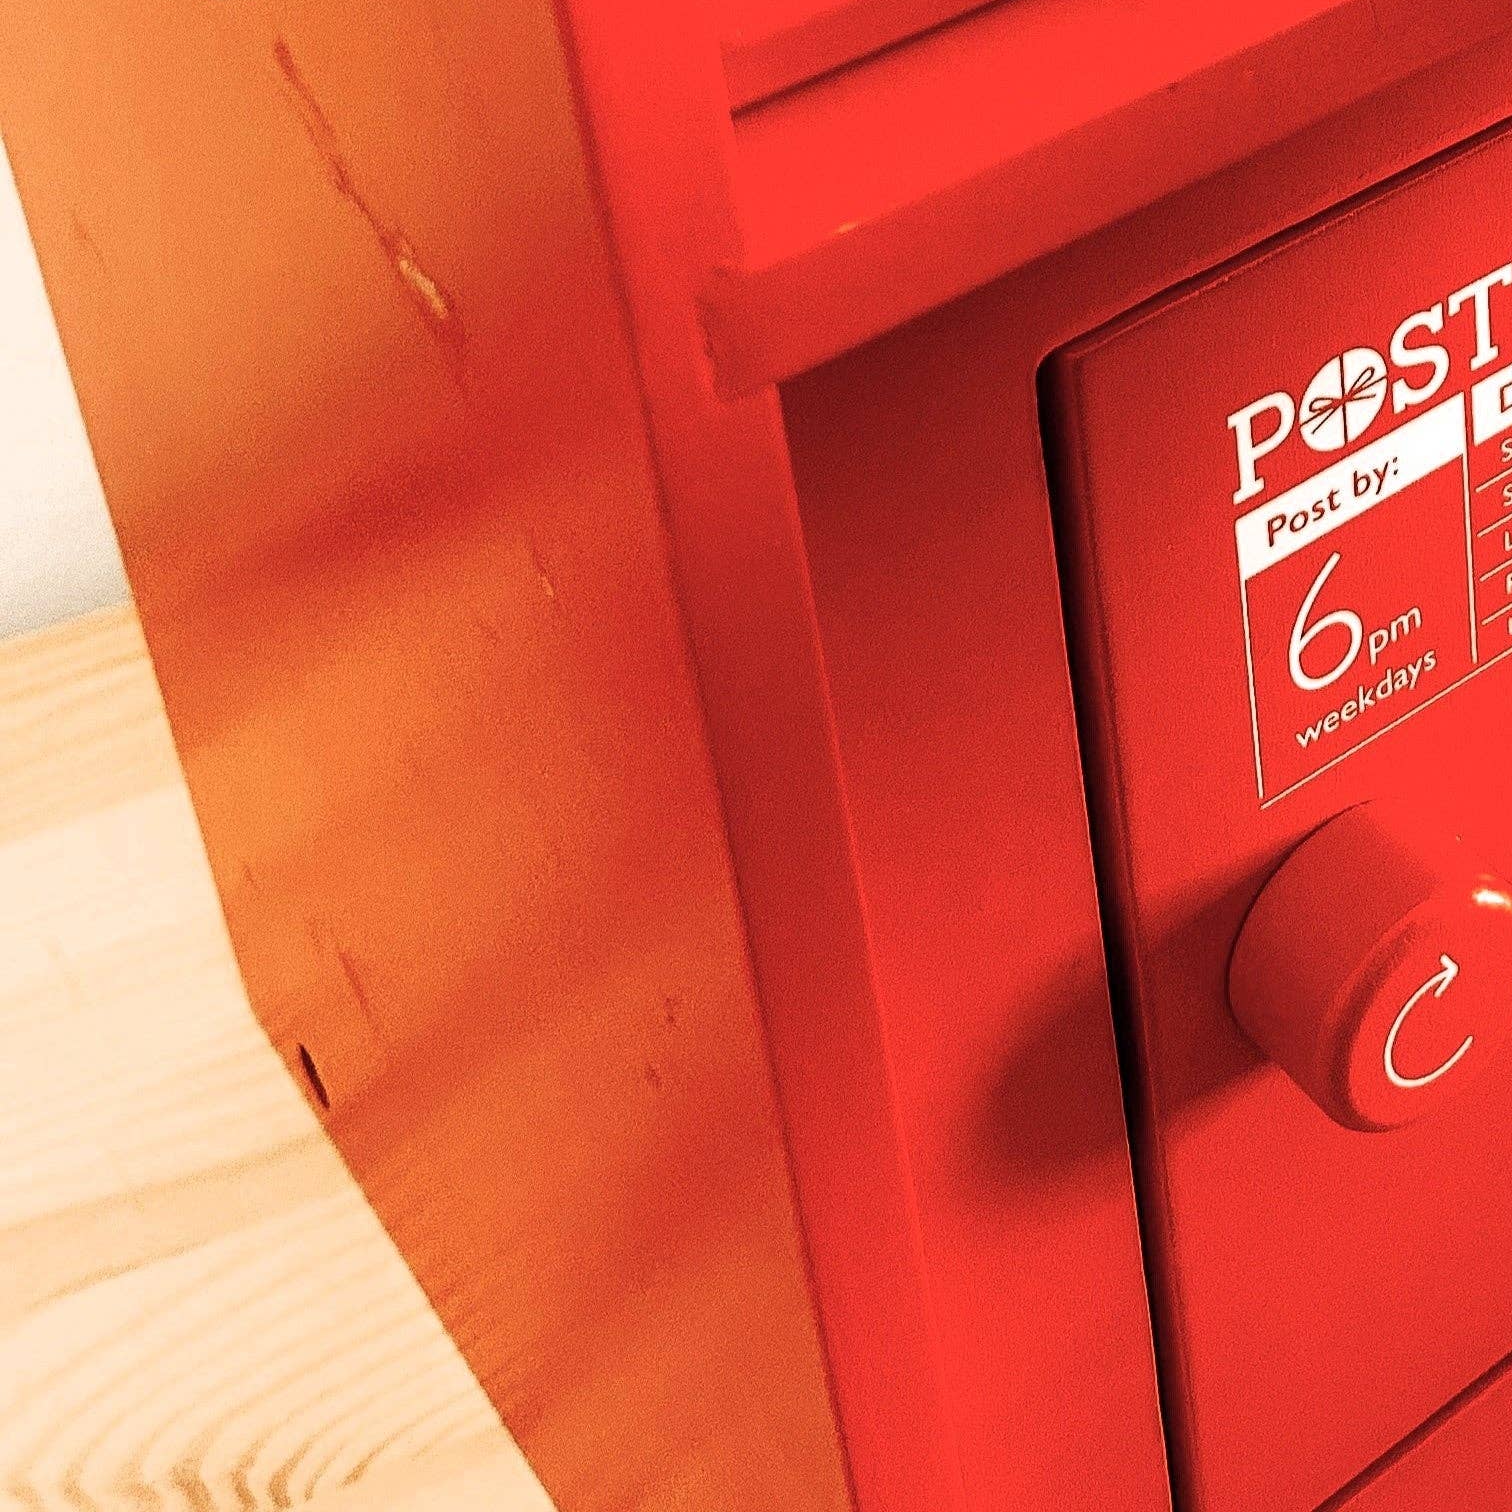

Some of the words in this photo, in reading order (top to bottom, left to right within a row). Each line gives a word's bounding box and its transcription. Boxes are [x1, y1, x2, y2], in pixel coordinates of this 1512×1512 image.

[1266, 488, 1342, 548] Post
[1352, 456, 1399, 498] by:
[1295, 650, 1437, 748] weekdays
